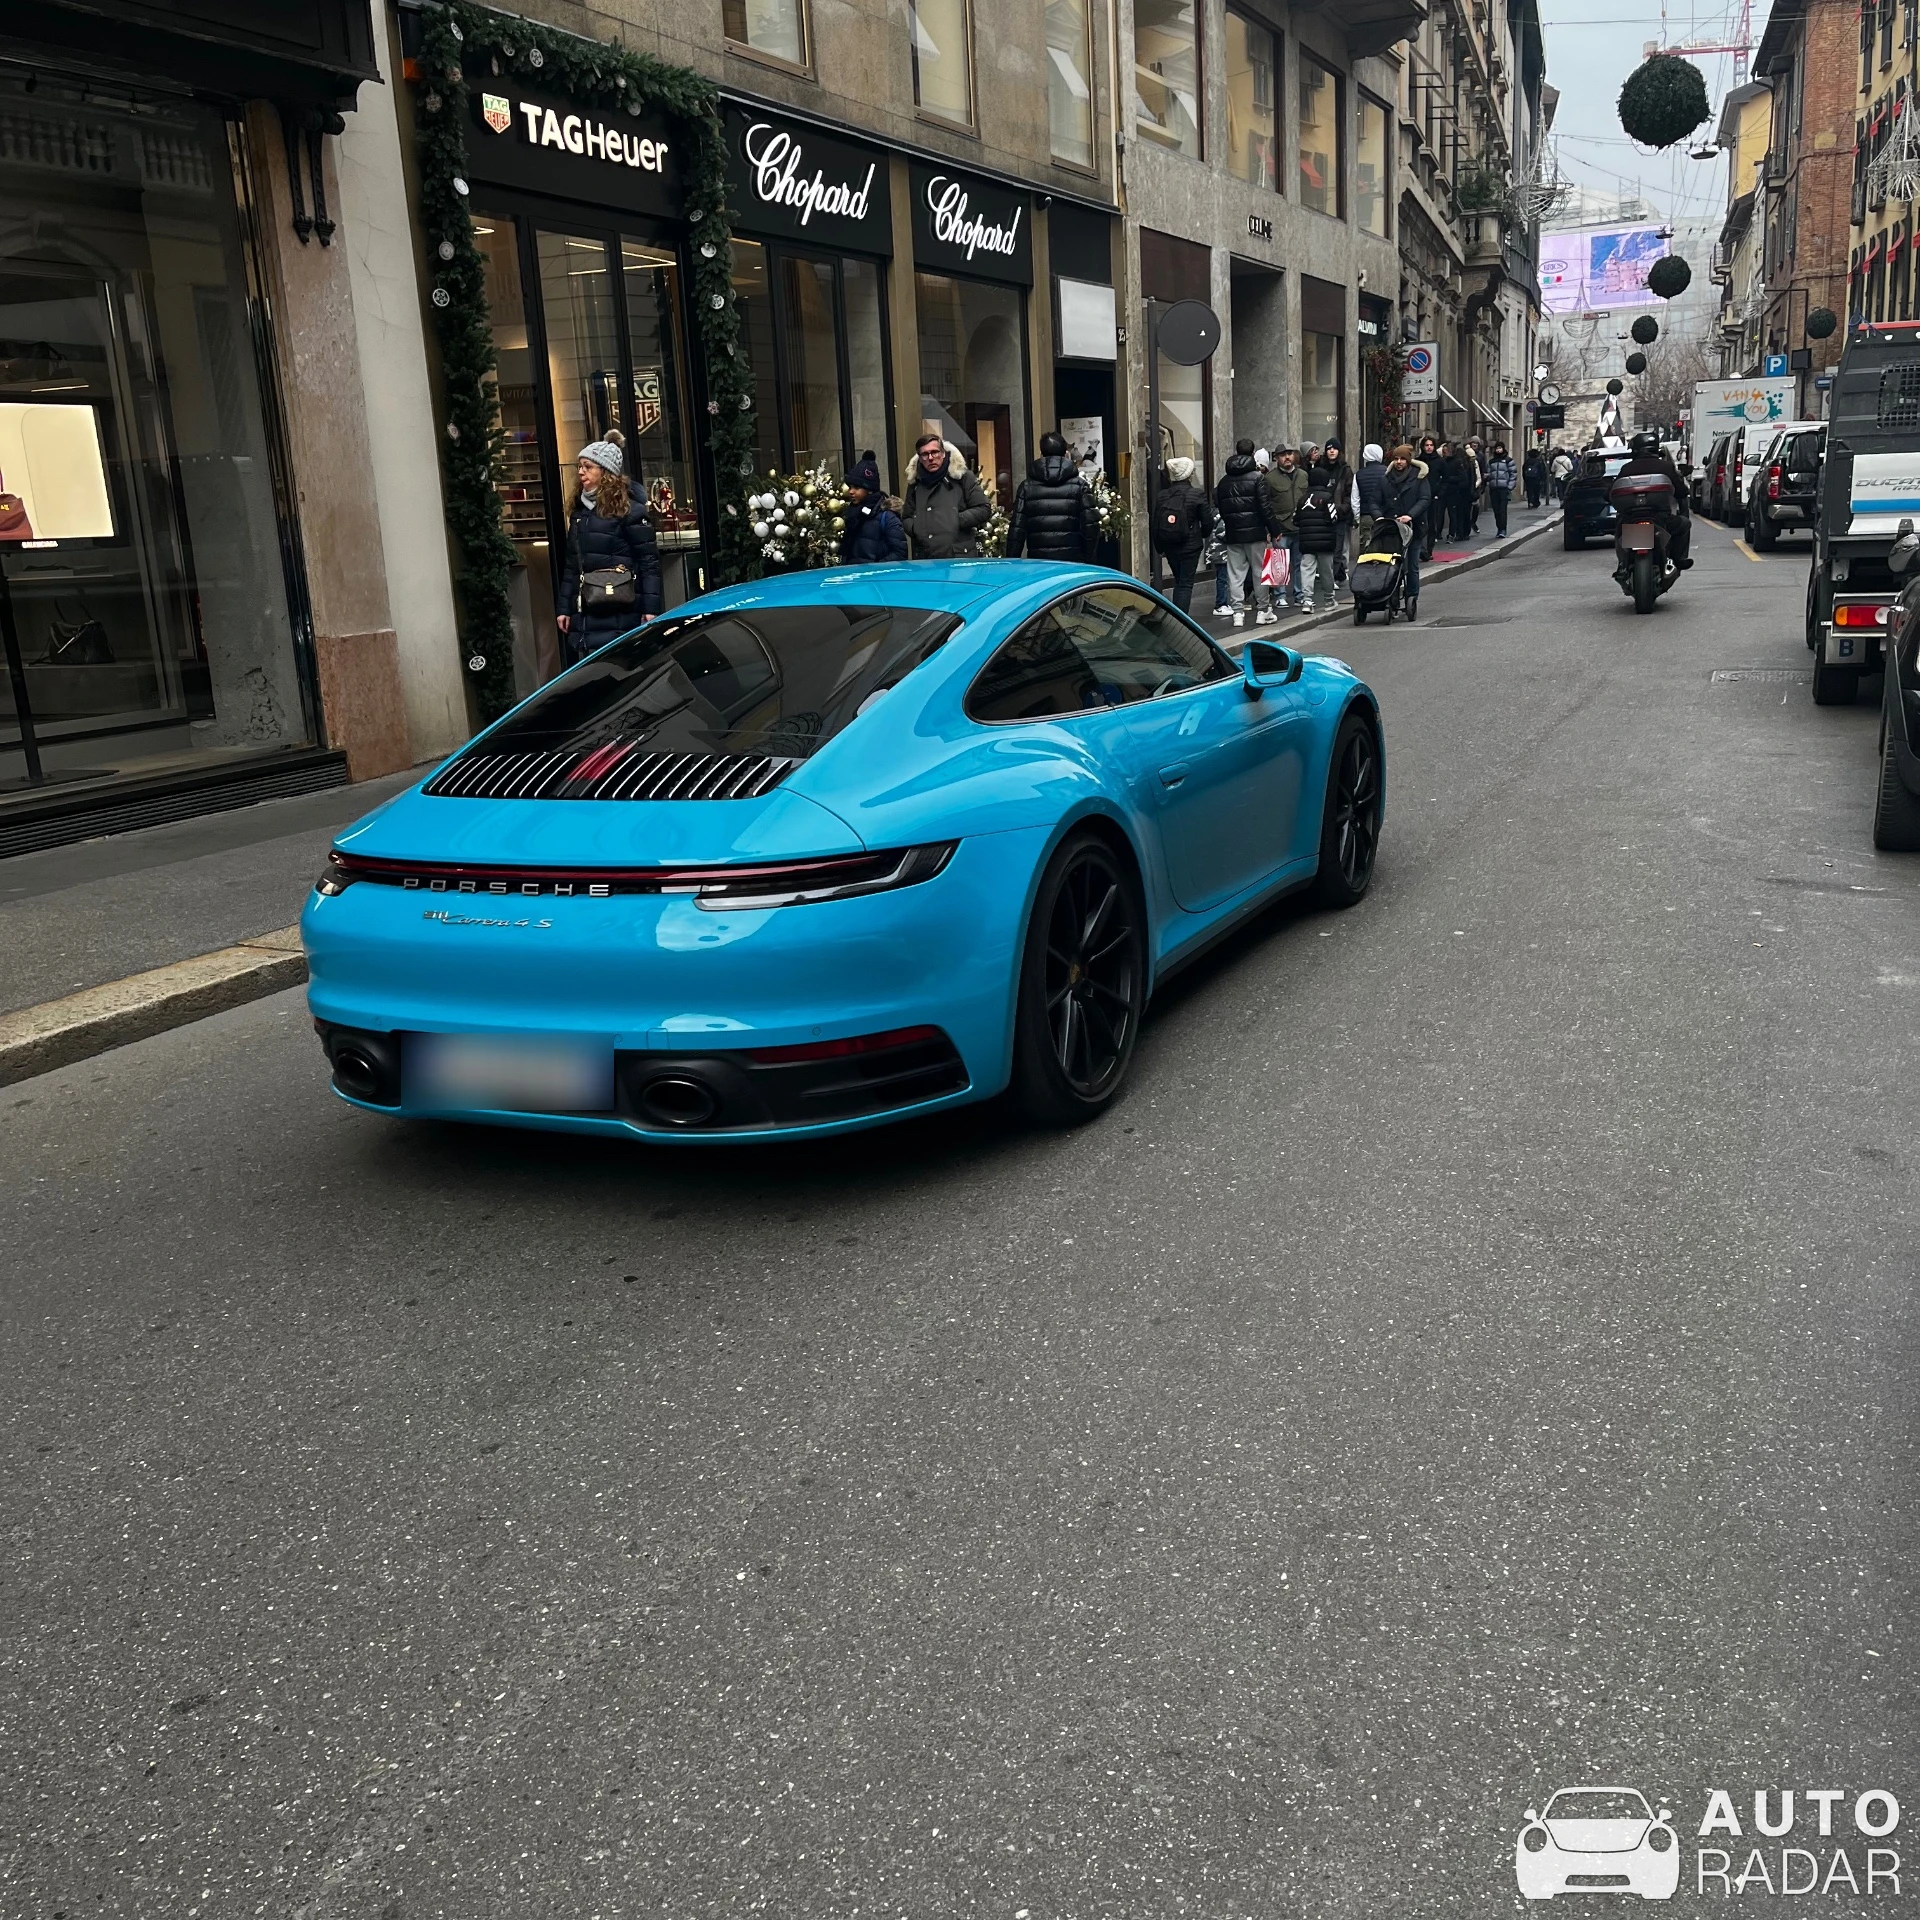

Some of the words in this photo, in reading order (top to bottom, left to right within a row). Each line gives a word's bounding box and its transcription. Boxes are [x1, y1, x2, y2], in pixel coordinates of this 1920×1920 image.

[485, 96, 508, 113] TAG
[486, 110, 509, 131] HEUER
[745, 123, 875, 225] Chopard
[927, 176, 1021, 260] Chopard
[1769, 357, 1782, 373] P
[1722, 389, 1749, 401] VAN
[1746, 404, 1768, 414] YOU
[403, 877, 610, 897] PORSCHE
[441, 914, 511, 927] Carrera
[514, 918, 531, 927] 4
[532, 918, 554, 928] S
